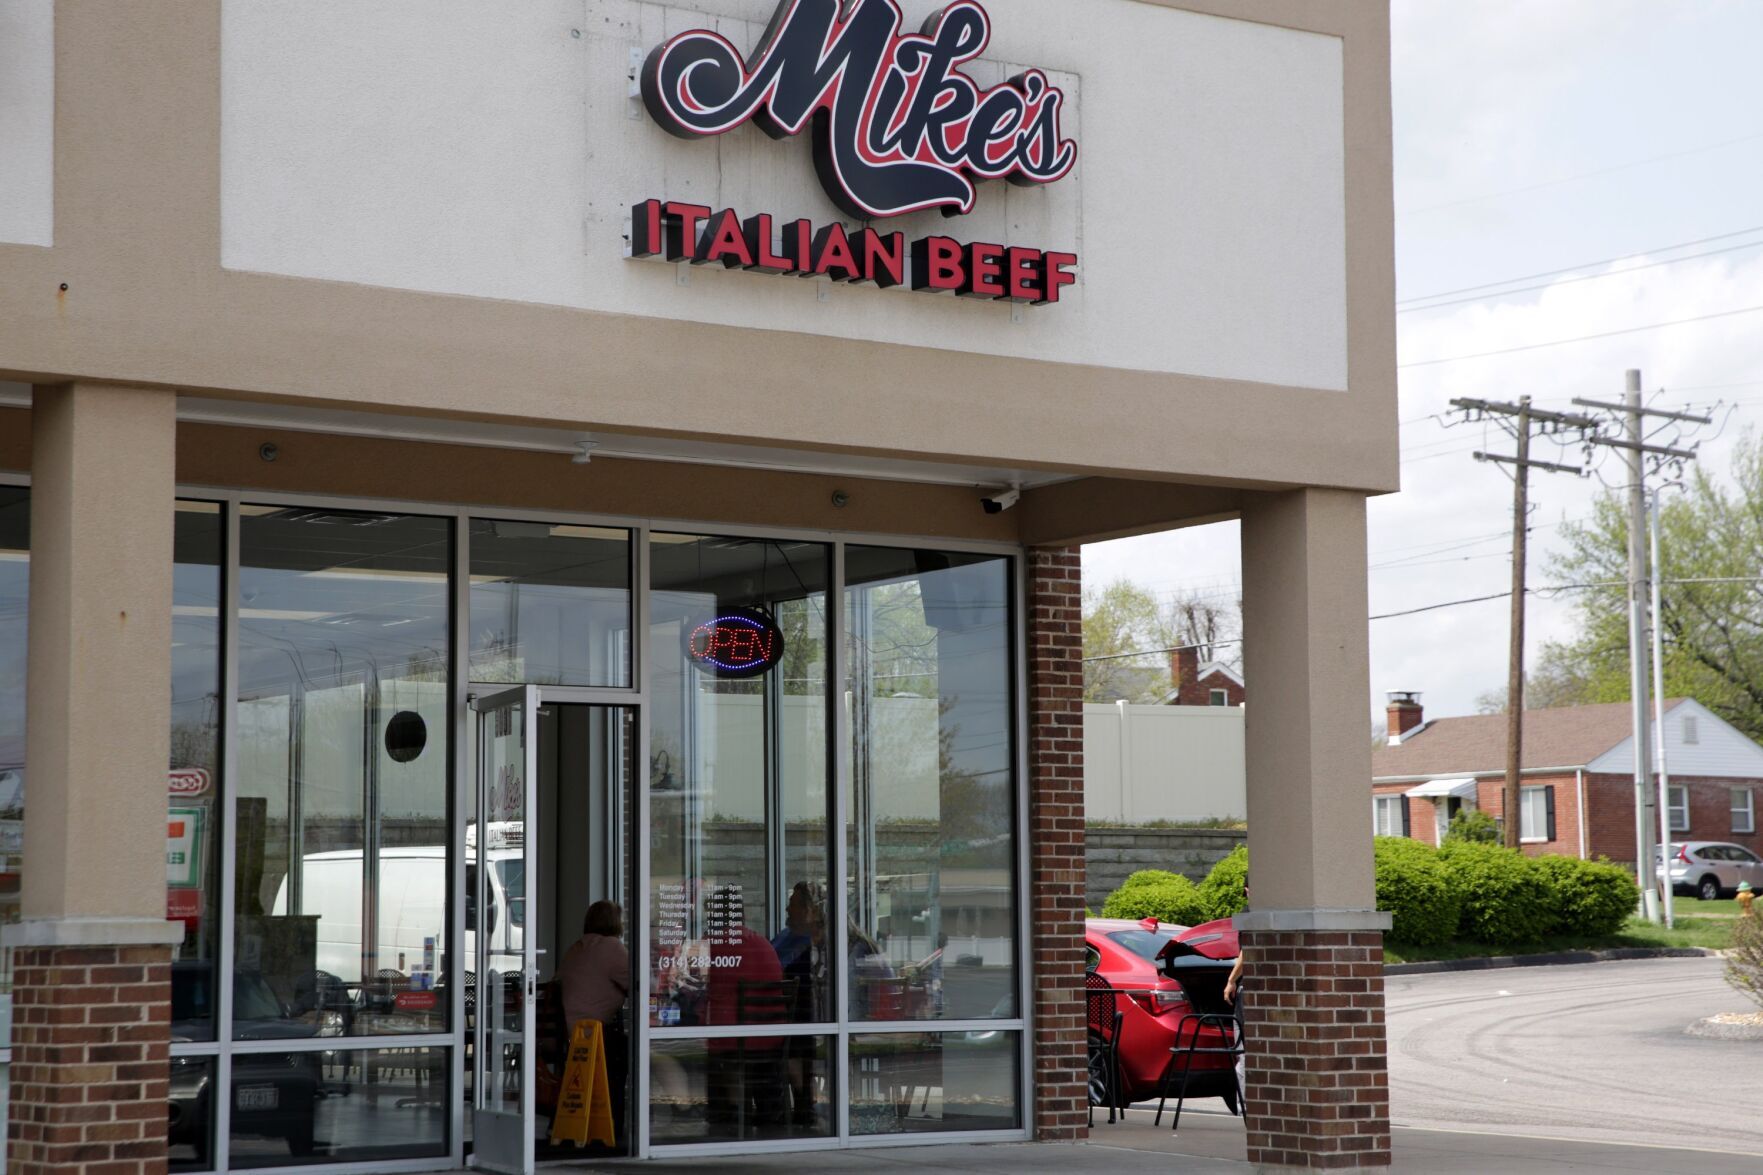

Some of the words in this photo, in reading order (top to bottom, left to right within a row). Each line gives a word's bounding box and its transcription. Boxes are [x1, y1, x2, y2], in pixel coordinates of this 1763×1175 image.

[641, 0, 1077, 218] Mike's
[632, 198, 904, 286] ITALIAN
[911, 235, 1077, 304] BEEF
[689, 625, 773, 661] OPEN
[659, 893, 685, 901] Tuesday
[659, 911, 688, 919] Thursday
[659, 956, 688, 970] (314)
